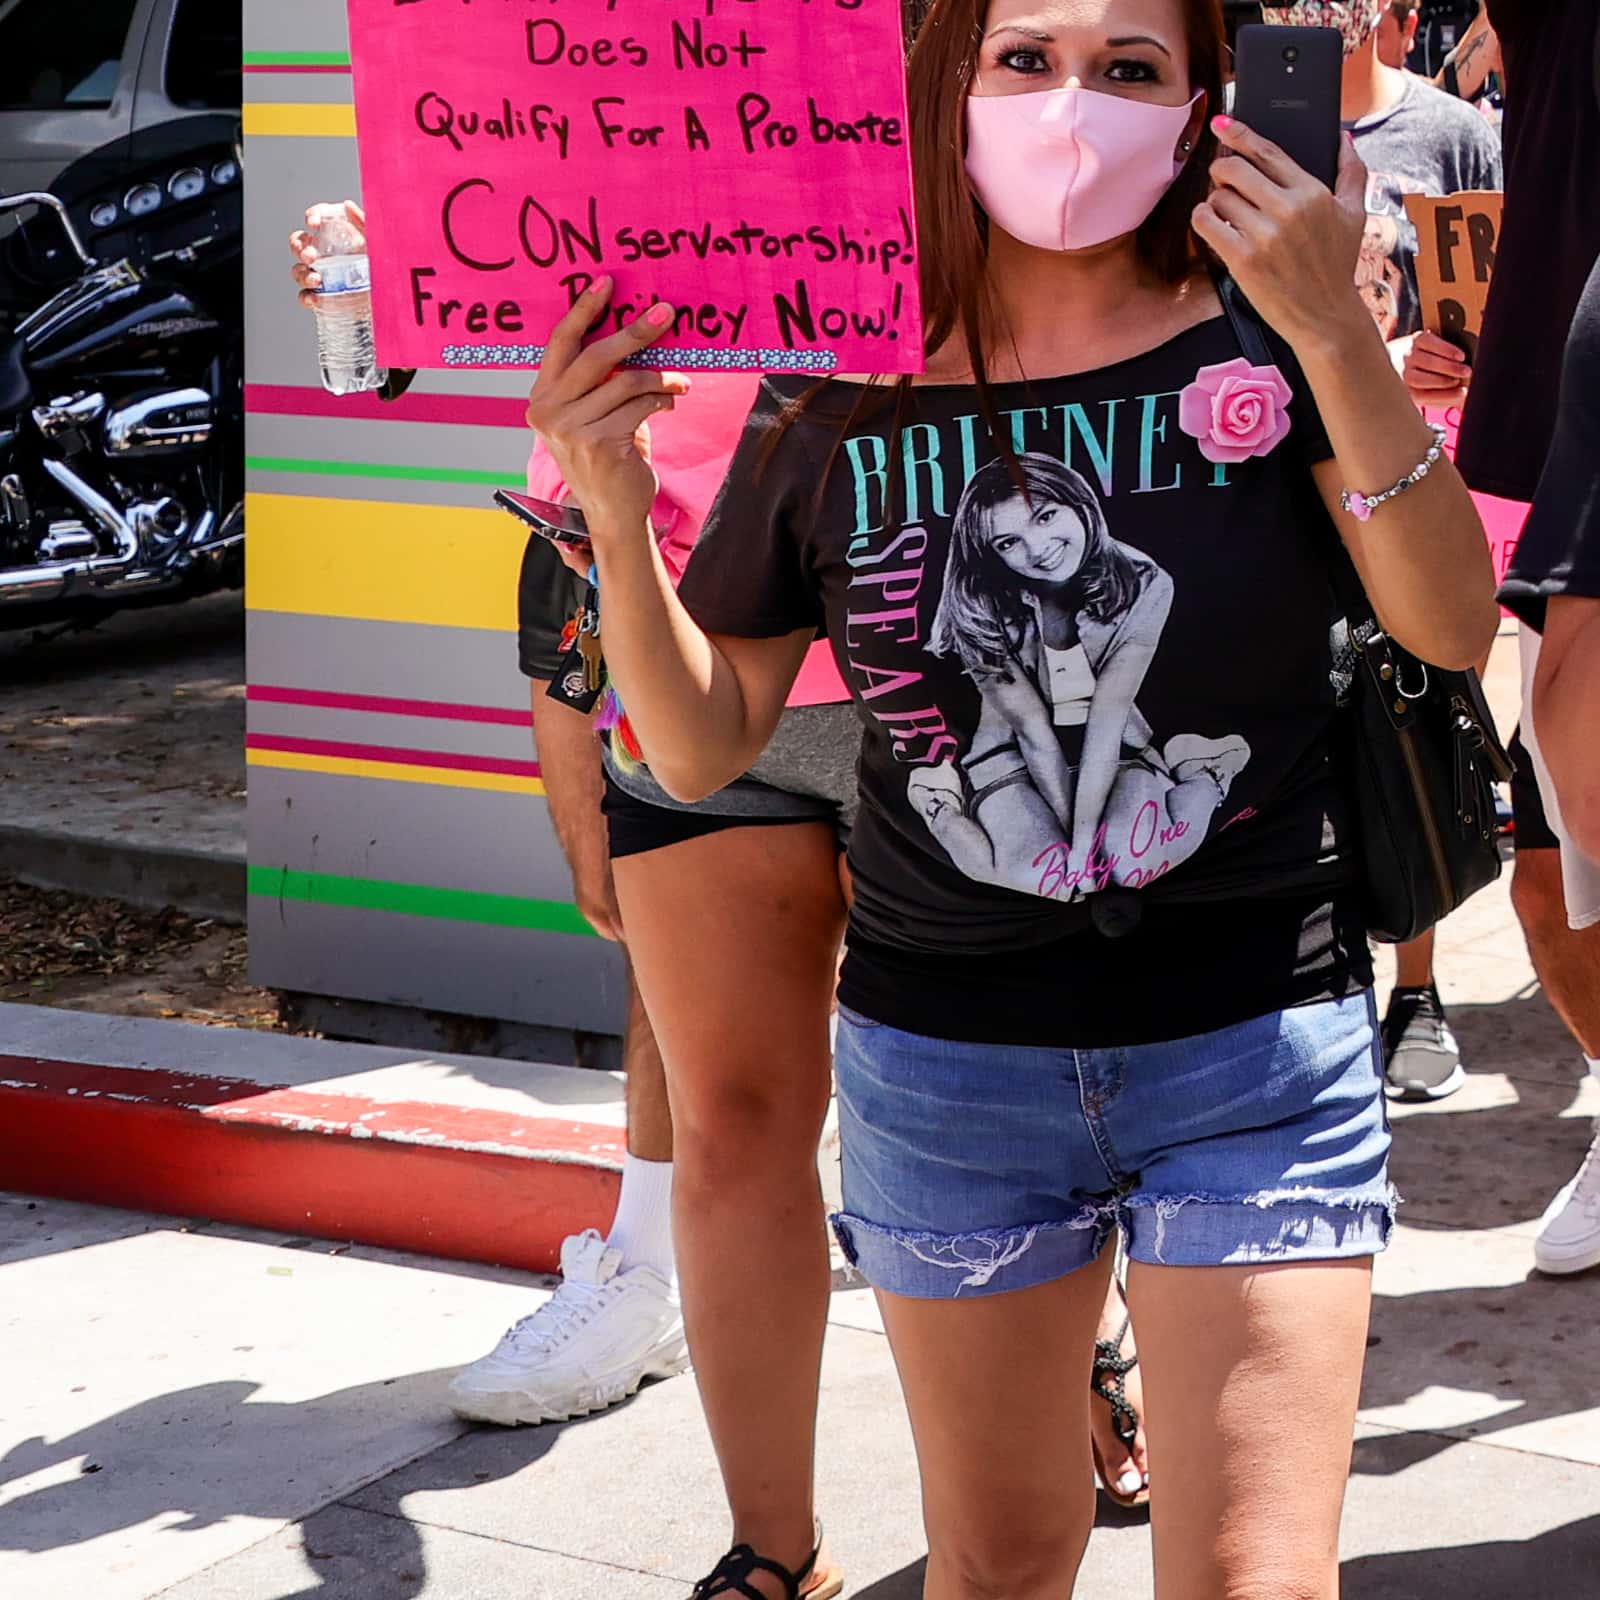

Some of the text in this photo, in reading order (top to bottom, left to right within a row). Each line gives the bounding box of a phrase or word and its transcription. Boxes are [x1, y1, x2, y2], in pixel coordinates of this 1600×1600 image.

[527, 17, 768, 71] Does Not
[414, 90, 570, 159] Qualify
[592, 98, 665, 149] For
[685, 106, 712, 152] A
[410, 267, 525, 334] Free
[773, 278, 903, 349] Now!
[841, 390, 1233, 538] BRITNE
[845, 526, 961, 767] SPEARS
[1032, 821, 1120, 898] Baby
[1129, 799, 1190, 859] One
